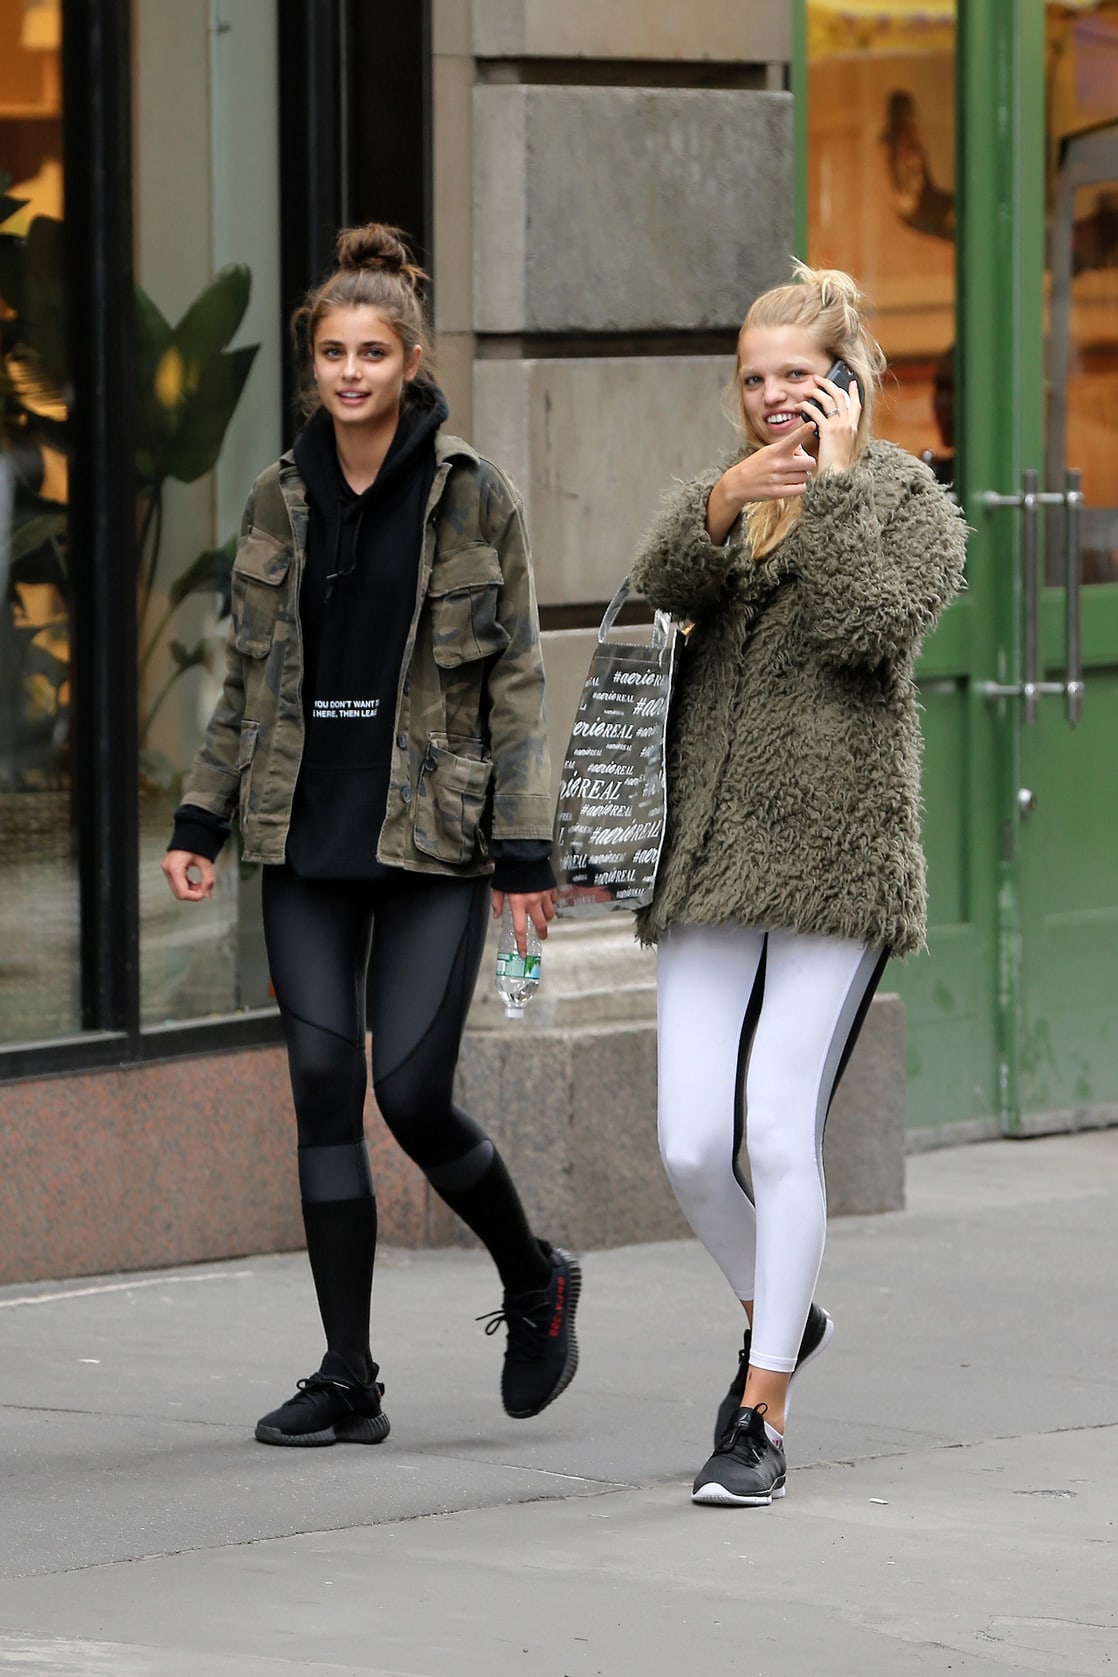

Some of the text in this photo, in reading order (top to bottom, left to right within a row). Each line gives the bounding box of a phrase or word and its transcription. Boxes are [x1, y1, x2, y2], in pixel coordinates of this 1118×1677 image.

[330, 700, 352, 709] DON'T
[353, 700, 375, 709] WANT
[339, 709, 360, 718] THEN
